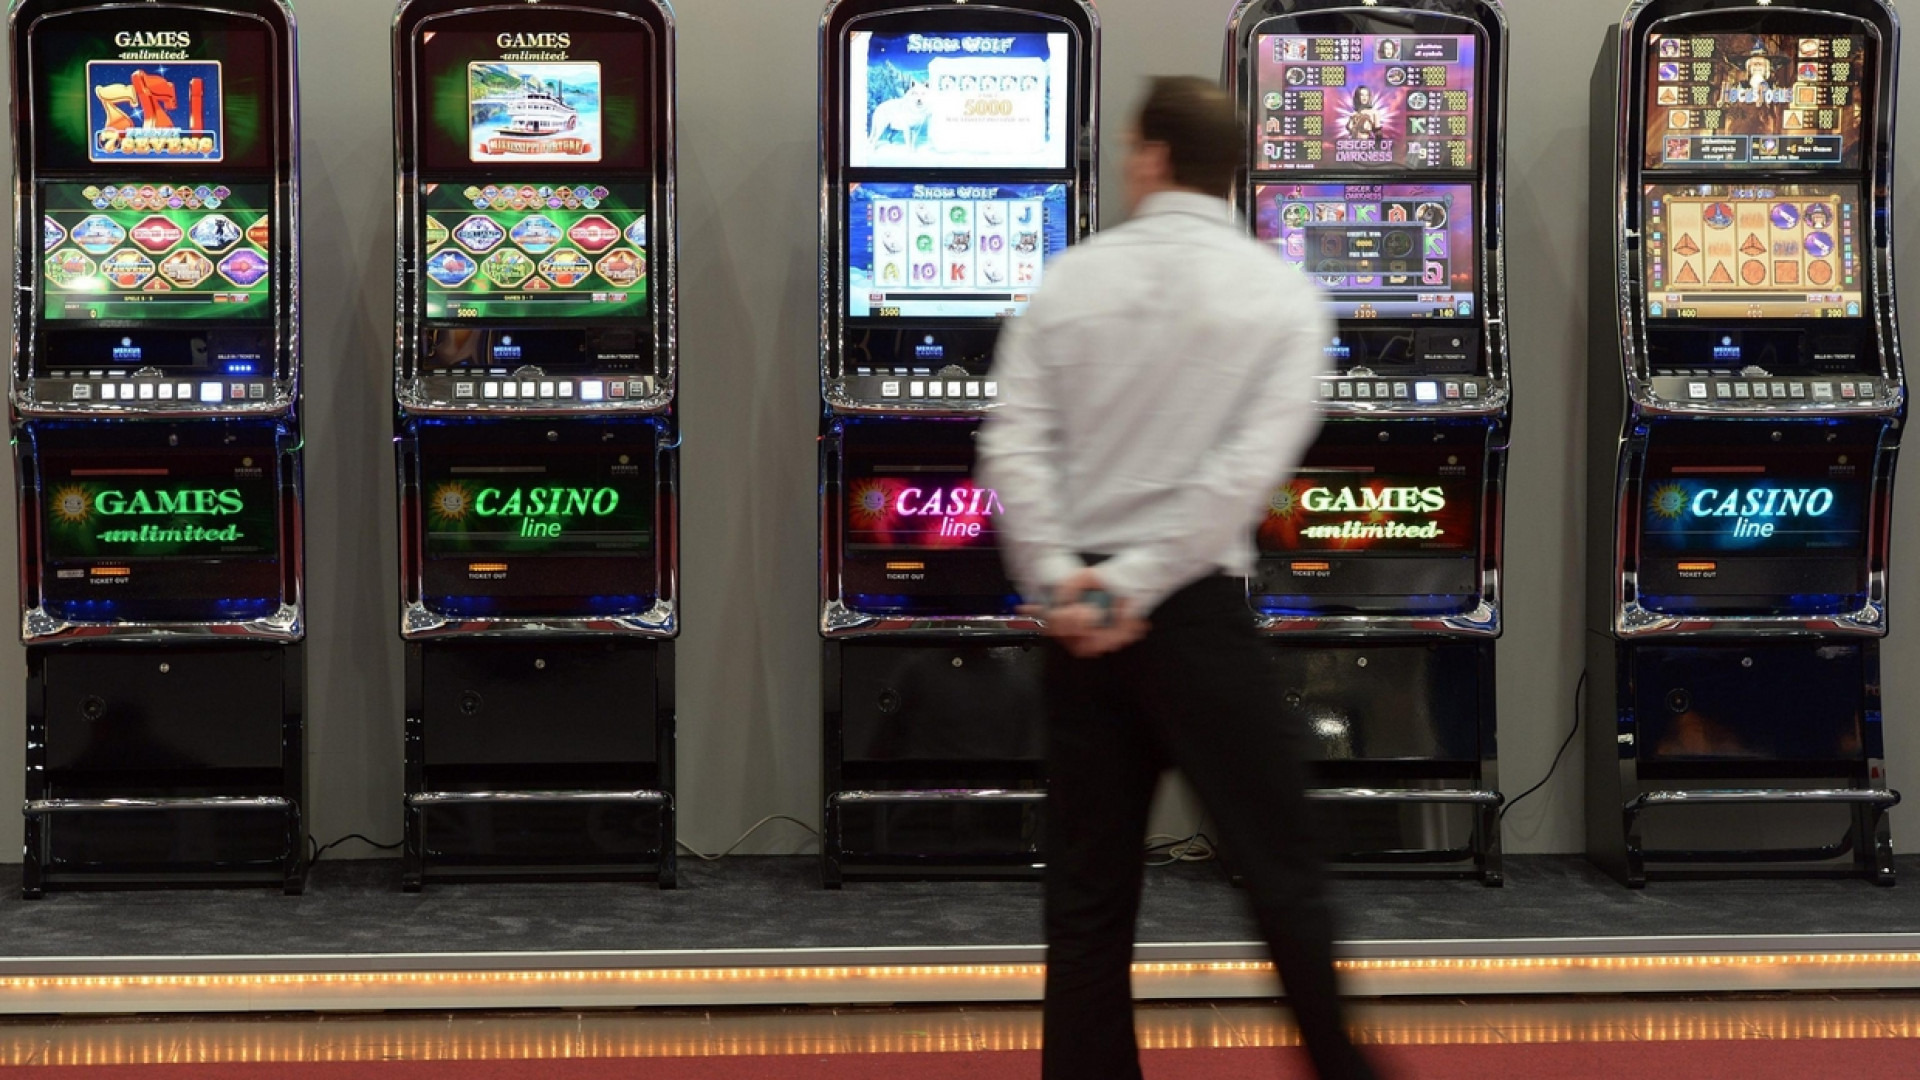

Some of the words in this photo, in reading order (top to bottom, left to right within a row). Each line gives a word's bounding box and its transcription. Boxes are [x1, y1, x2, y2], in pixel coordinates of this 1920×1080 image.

[115, 32, 191, 48] GAMES
[496, 32, 571, 48] GAMES
[963, 99, 1013, 116] 5000
[1409, 117, 1426, 134] K
[100, 127, 119, 153] 7
[120, 137, 214, 154] SEVENS
[950, 206, 968, 224] Q
[1018, 206, 1032, 224] J
[1353, 204, 1376, 222] K
[916, 234, 933, 252] Q
[1425, 232, 1444, 255] K
[950, 262, 966, 280] K
[1423, 261, 1444, 285] Q
[458, 308, 478, 317] 5000
[95, 488, 244, 516] GAMES
[475, 487, 619, 516] CASINO
[896, 487, 1005, 516] CASIN
[1301, 486, 1446, 513] GAMES
[1691, 487, 1834, 517] CASINO
[520, 517, 562, 537] line
[940, 517, 981, 537] line
[1733, 517, 1774, 538] line
